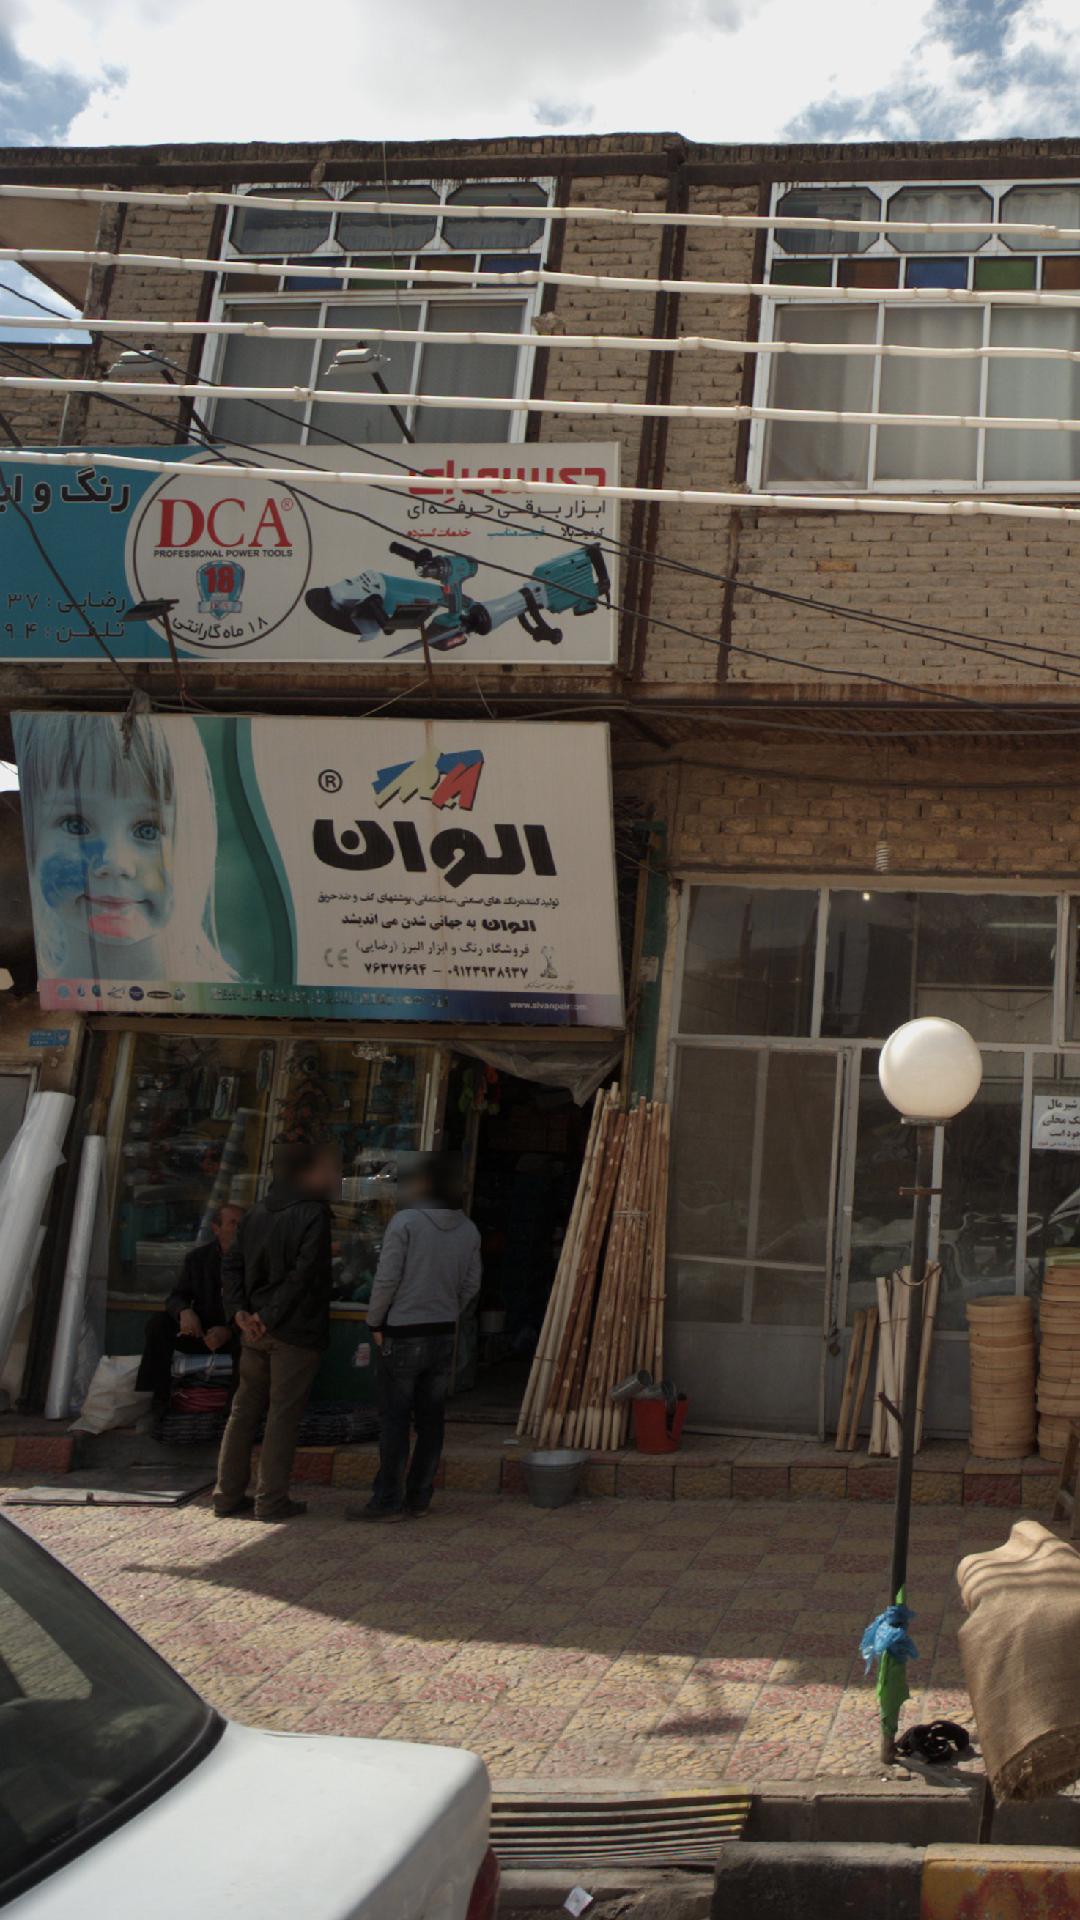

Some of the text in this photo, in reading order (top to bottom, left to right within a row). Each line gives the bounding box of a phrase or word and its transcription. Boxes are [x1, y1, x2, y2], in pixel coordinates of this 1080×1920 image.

[61, 467, 130, 512] رنگ
[33, 483, 51, 512] و
[407, 500, 606, 519] ابزار برقی حرفه ای
[154, 497, 292, 548] DCA
[439, 527, 472, 537] خدمات
[154, 549, 293, 558] PROFESSIONAL POWER TOOLS
[172, 617, 221, 640] گارانتی
[223, 626, 244, 638] ماه
[313, 818, 557, 888] الوان
[341, 912, 537, 934] الوان به جهانی شدن می اندیشد
[401, 940, 424, 954] البرز
[428, 941, 448, 956] ابزار
[451, 945, 457, 955] و
[459, 942, 483, 957] رنگ
[486, 943, 530, 958] فروشگاه
